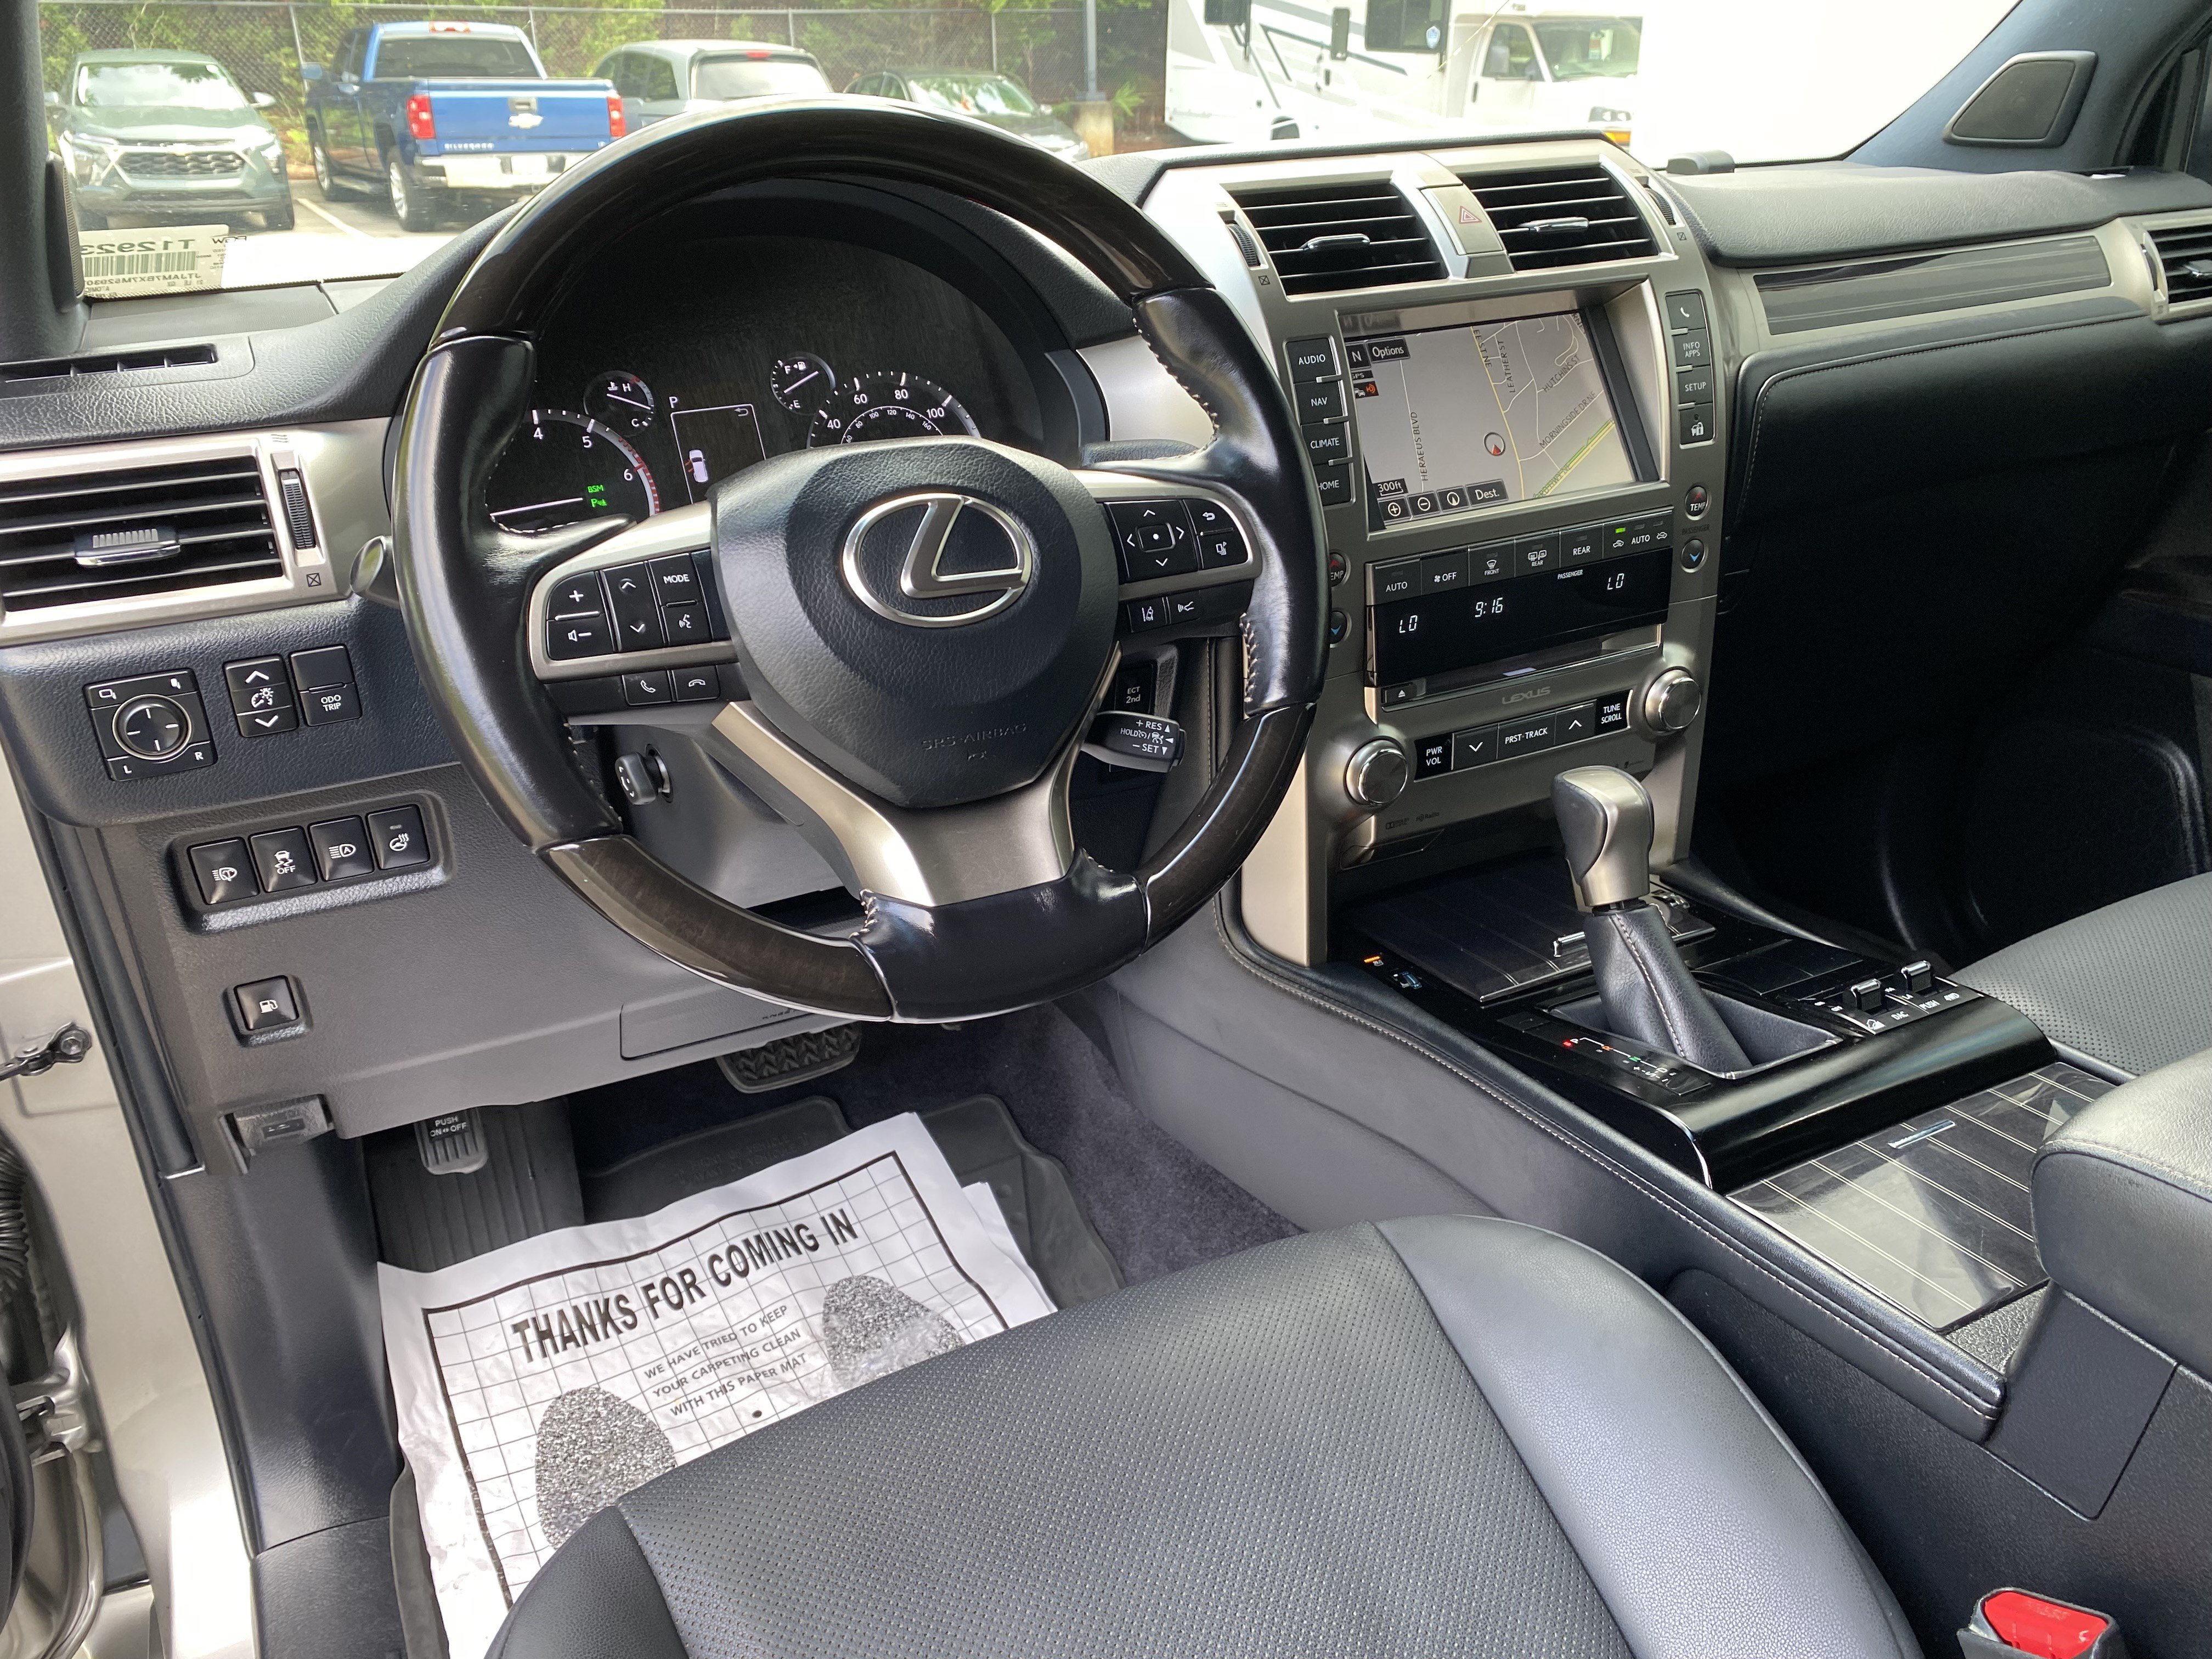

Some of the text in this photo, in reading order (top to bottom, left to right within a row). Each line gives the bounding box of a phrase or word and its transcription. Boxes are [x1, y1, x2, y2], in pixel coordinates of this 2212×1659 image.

[1683, 341, 1700, 351] INFO
[1352, 351, 1362, 362] N
[1372, 346, 1404, 359] Options
[1685, 349, 1701, 358] APPS
[1298, 353, 1325, 366] AUDIO
[1498, 340, 1516, 393] LEATHER ST
[1543, 361, 1576, 393] HUTCHINS
[623, 383, 631, 392] H
[1685, 381, 1707, 392] SETUP
[854, 393, 867, 405] 60
[895, 388, 909, 400] 80
[669, 396, 678, 409] P
[1311, 397, 1328, 407] NAV
[868, 410, 879, 419] 100
[905, 411, 915, 420] 140
[926, 408, 945, 419] 100
[827, 418, 841, 430] 40
[855, 420, 864, 428] 80
[921, 420, 932, 431] 160
[1539, 407, 1581, 449] MORNINGSIDE
[533, 427, 544, 439] 4
[582, 436, 592, 449] 5
[1310, 437, 1340, 449] CLIMATE
[1410, 412, 1429, 481] HERAEUS BLVD
[623, 469, 633, 481] 6
[587, 484, 604, 494] BSM
[1378, 481, 1402, 492] 300ft
[1475, 488, 1500, 500] Dest.
[1690, 501, 1706, 511] TEMP
[1631, 534, 1650, 545] AUTO
[1573, 545, 1590, 556] REAR
[663, 573, 690, 584] MODE
[1330, 570, 1344, 581] EMP
[1442, 572, 1457, 582] OFF
[1558, 569, 1583, 579] PASSENGER
[1386, 582, 1408, 592] AUTO
[1607, 573, 1624, 590] LO
[1475, 597, 1503, 618] 9:16
[1399, 615, 1418, 634] LO
[1127, 686, 1141, 695] ECT
[1502, 686, 1551, 704] LEXUS
[320, 694, 341, 706] ODO
[1126, 694, 1141, 703] 2nd
[323, 702, 341, 712] TRIP
[1603, 703, 1621, 714] TUNE
[1601, 713, 1622, 724] SCROLL
[1145, 720, 1162, 731] RES
[1120, 727, 1138, 737] HOLD
[1142, 743, 1159, 754] SET
[1426, 746, 1443, 757] PWR
[195, 752, 204, 760] R
[1426, 757, 1441, 766] VOL
[123, 765, 132, 774] L
[276, 864, 295, 875] OFF
[1919, 992, 1961, 1011] PUSH 4WD
[1891, 1011, 1909, 1020] DAC
[435, 1115, 458, 1127] PUSH
[430, 1121, 466, 1137] ON OFF
[511, 1208, 859, 1364] THANKS FOR COMING IN
[644, 1305, 788, 1379] WE HAVE TRIED TO KEEP
[652, 1328, 802, 1397] YOUR CARPETING CLEAN
[670, 1352, 808, 1416] WITH THIS PAPER MAT
